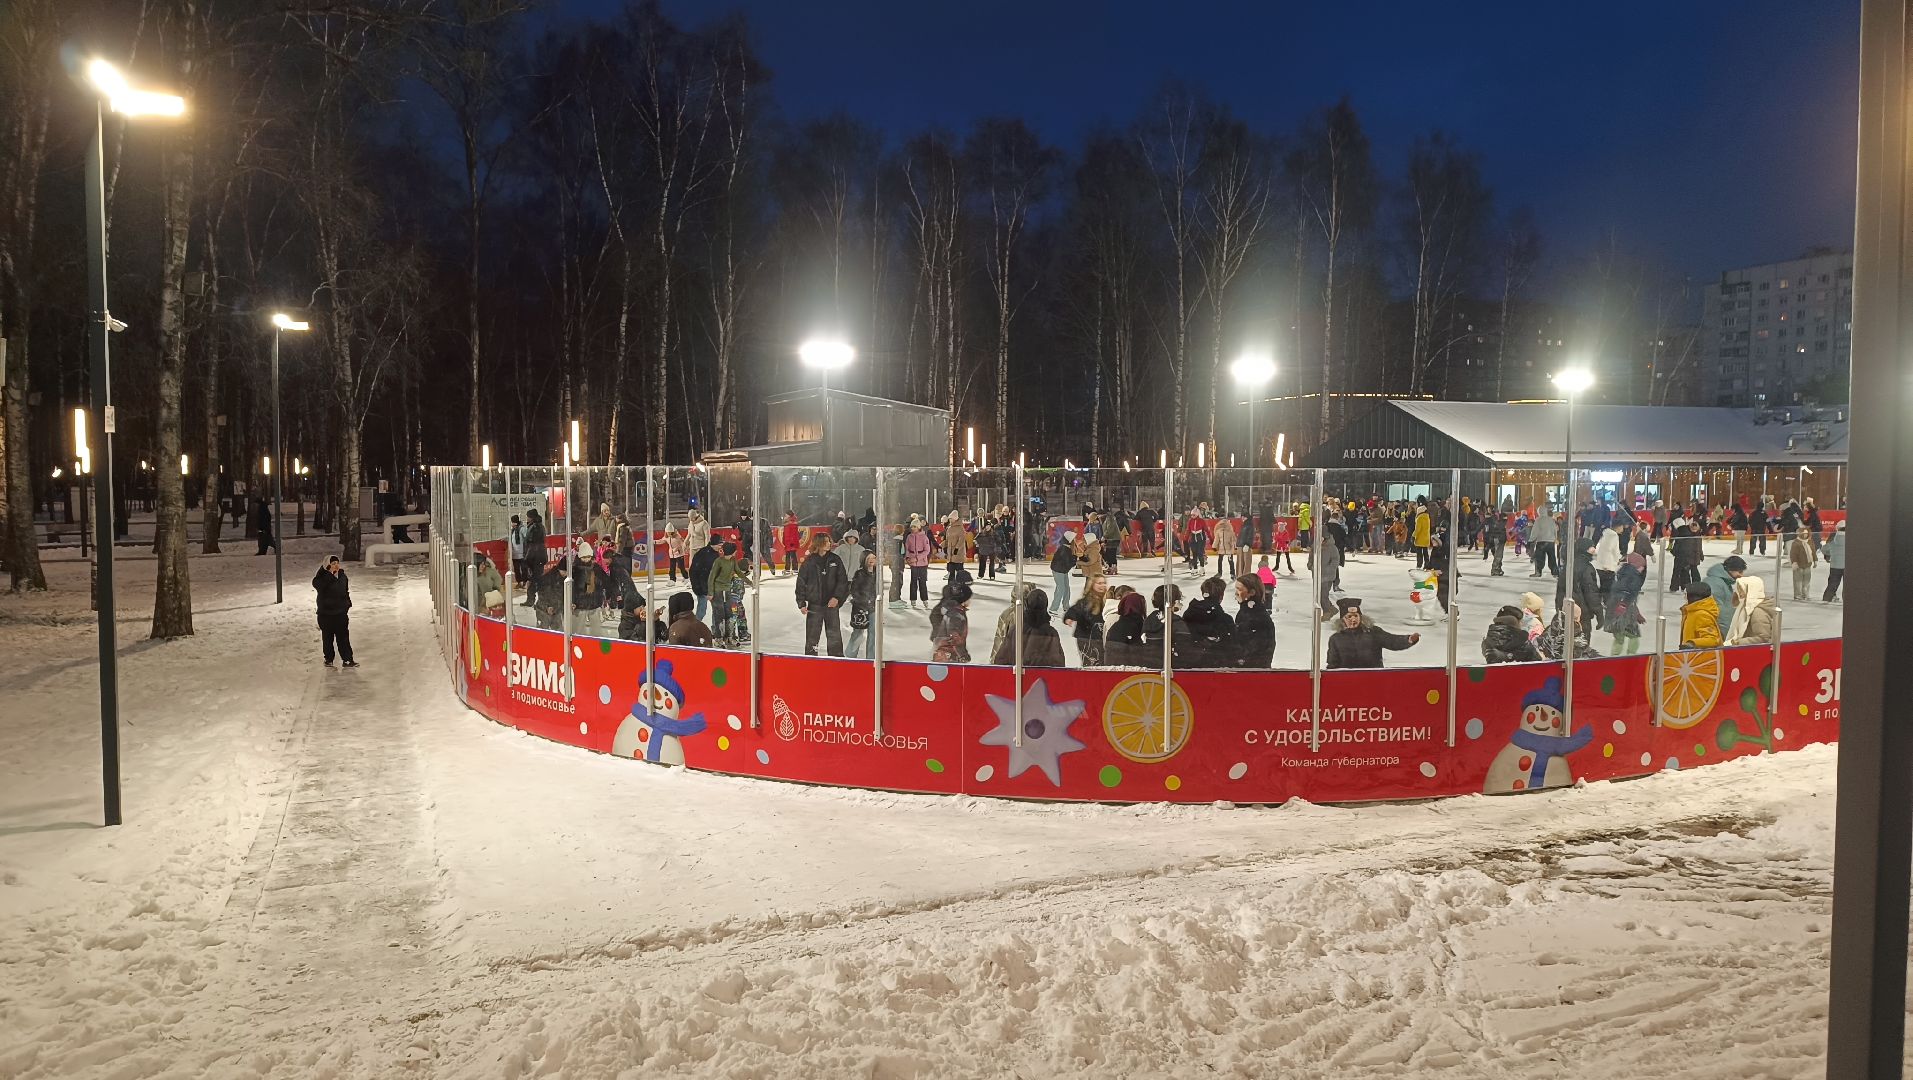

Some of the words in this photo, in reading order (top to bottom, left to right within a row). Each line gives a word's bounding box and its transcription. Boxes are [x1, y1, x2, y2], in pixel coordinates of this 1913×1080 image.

[1343, 447, 1425, 460] АВТОГОРОДОК
[803, 712, 855, 729] ПАРКИ
[803, 728, 928, 751] ПОДМОСКОВЬЯ
[1244, 729, 1258, 744] С
[1264, 726, 1431, 747] УДОВОЛЬСТВИЕМ!
[1281, 756, 1329, 769] Команда
[1331, 755, 1400, 769] губернатора
